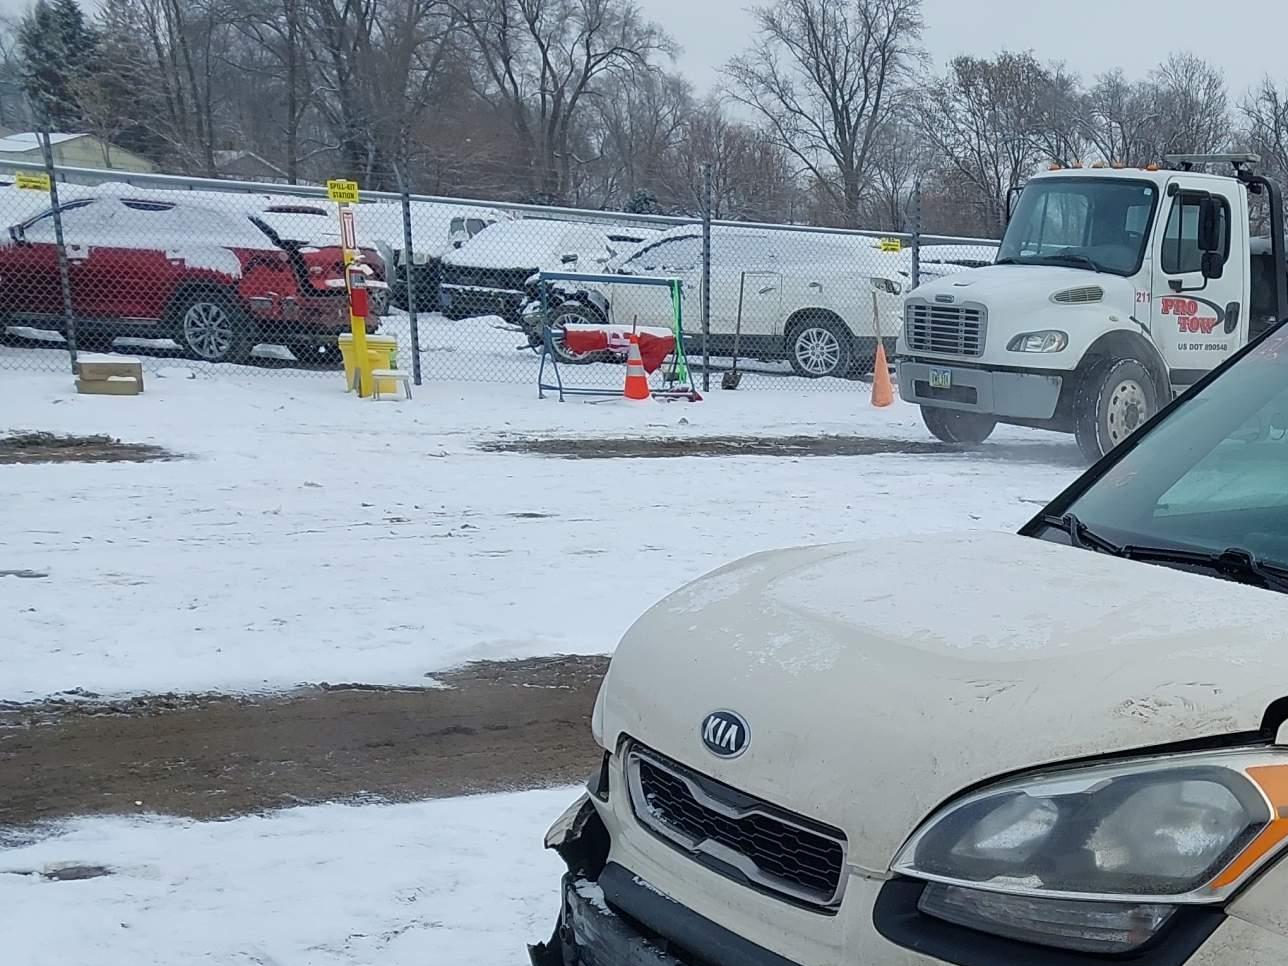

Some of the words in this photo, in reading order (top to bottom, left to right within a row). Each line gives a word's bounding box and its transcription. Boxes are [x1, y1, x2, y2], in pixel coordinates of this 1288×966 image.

[332, 191, 355, 199] STATION
[1136, 291, 1151, 304] 211
[1161, 298, 1199, 316] PRO
[1177, 315, 1217, 335] TOW
[1177, 343, 1188, 351] US
[1189, 343, 1204, 351] DOT
[703, 715, 739, 752] KIA
